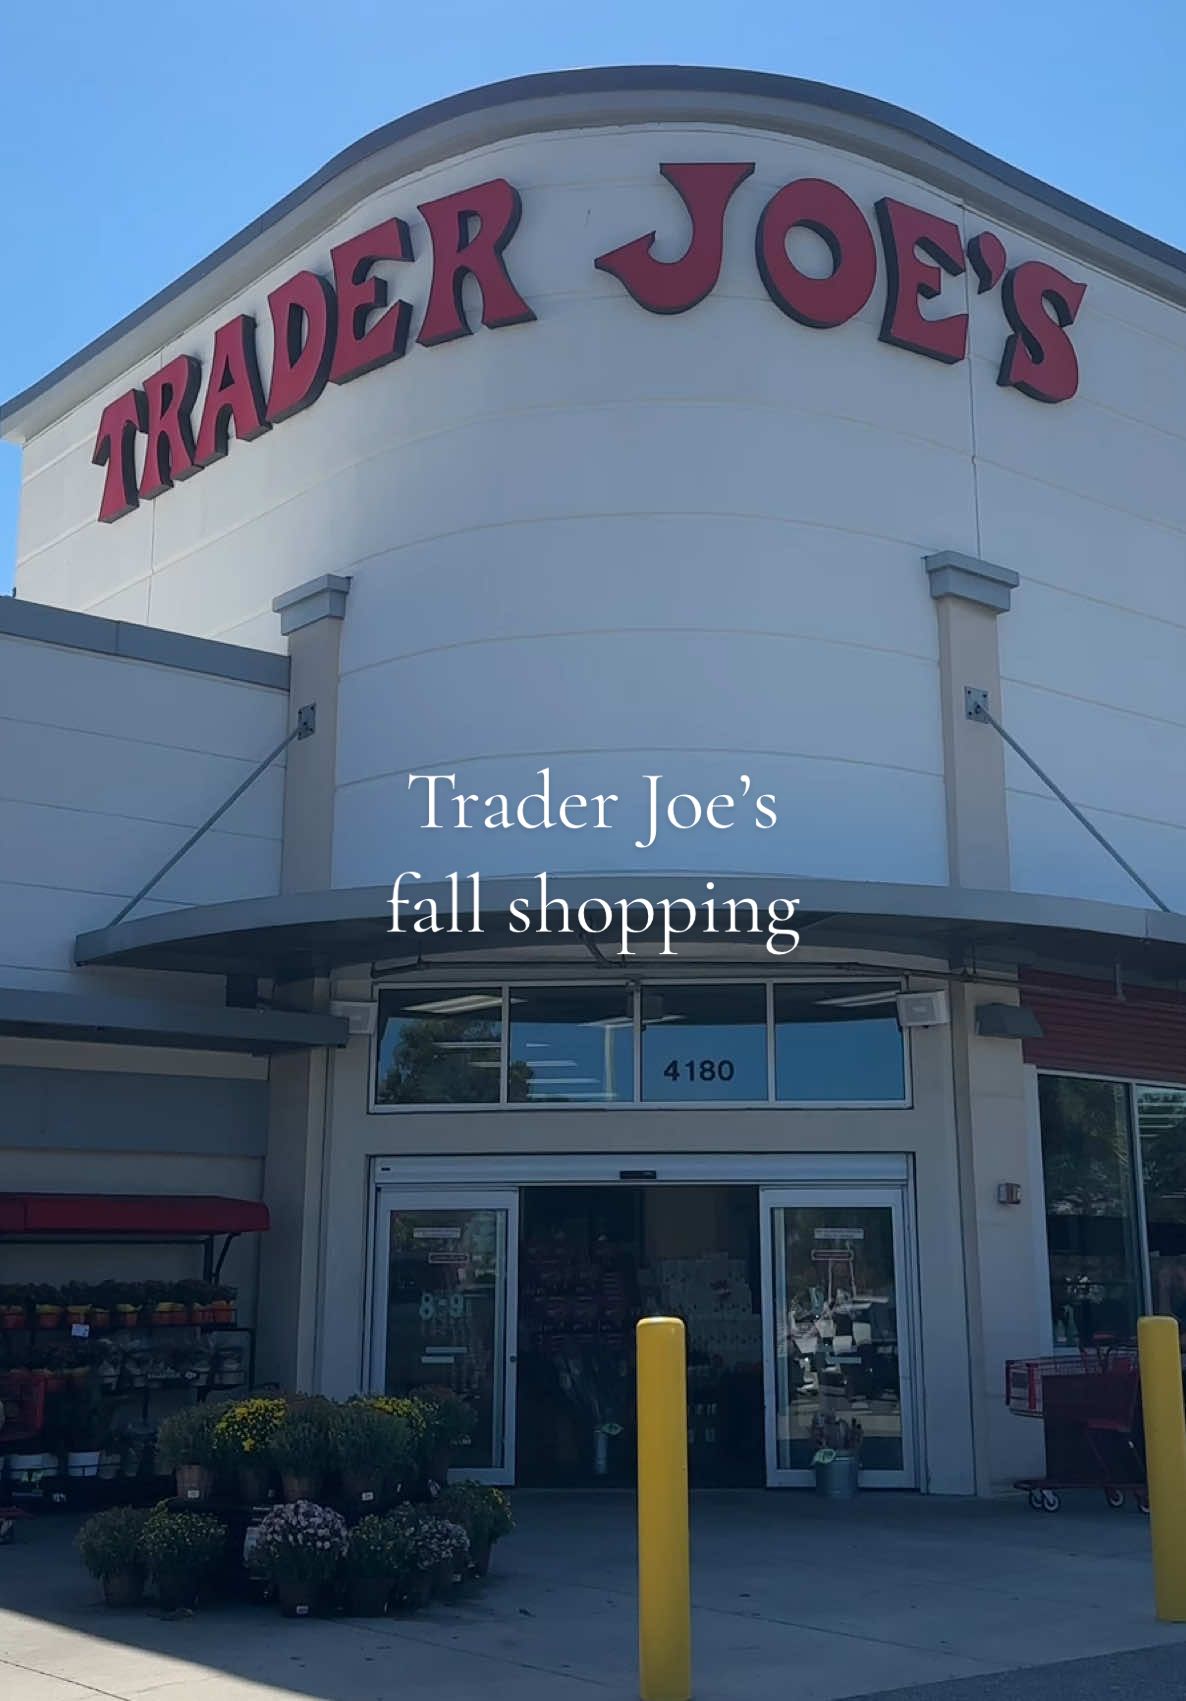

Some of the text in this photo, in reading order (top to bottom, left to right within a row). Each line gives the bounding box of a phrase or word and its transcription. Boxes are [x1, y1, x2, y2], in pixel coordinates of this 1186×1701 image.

[92, 162, 1087, 524] TRADER JOE'S
[663, 1060, 735, 1082] 4180
